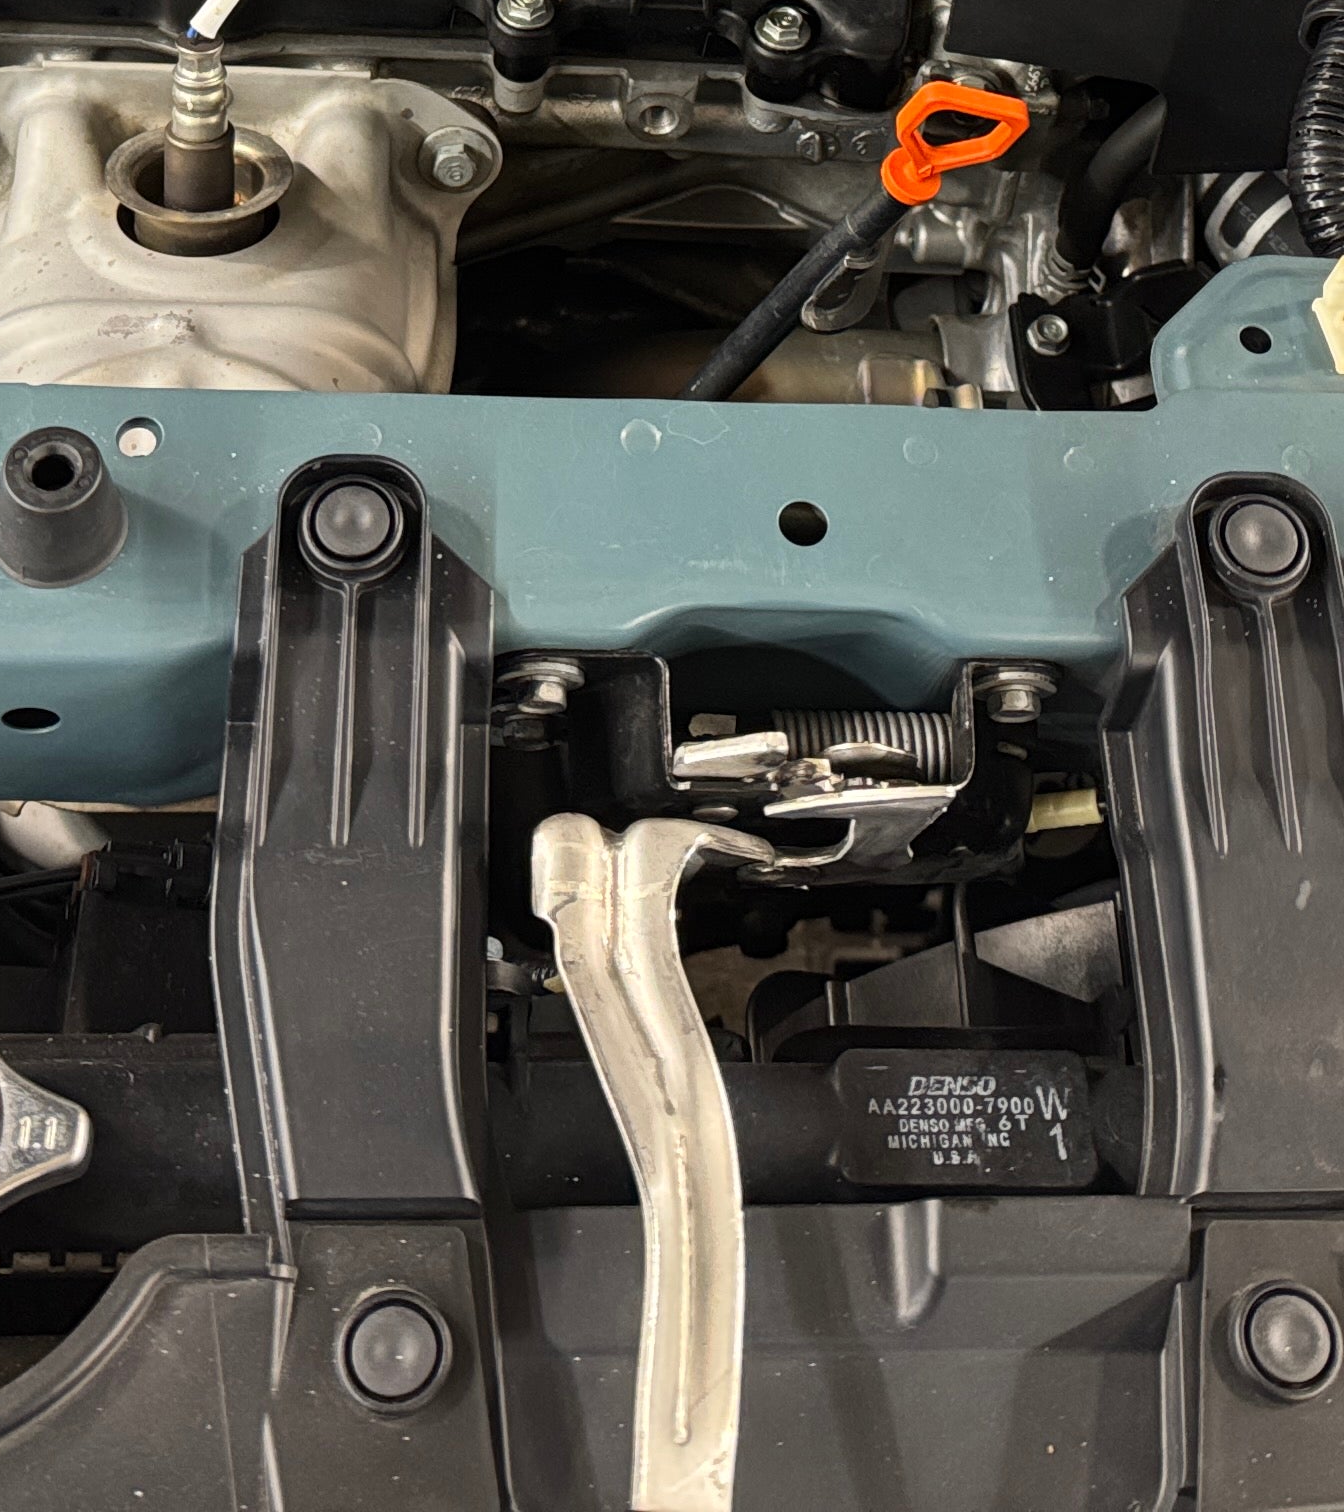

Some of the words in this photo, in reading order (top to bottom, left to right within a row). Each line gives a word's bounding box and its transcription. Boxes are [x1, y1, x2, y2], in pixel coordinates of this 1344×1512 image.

[908, 1075, 997, 1096] DENSO
[867, 1097, 1035, 1116] AA223000-7900
[19, 1115, 58, 1151] 1.1
[899, 1118, 950, 1134] DENSO
[887, 1134, 973, 1150] MICHIGAN
